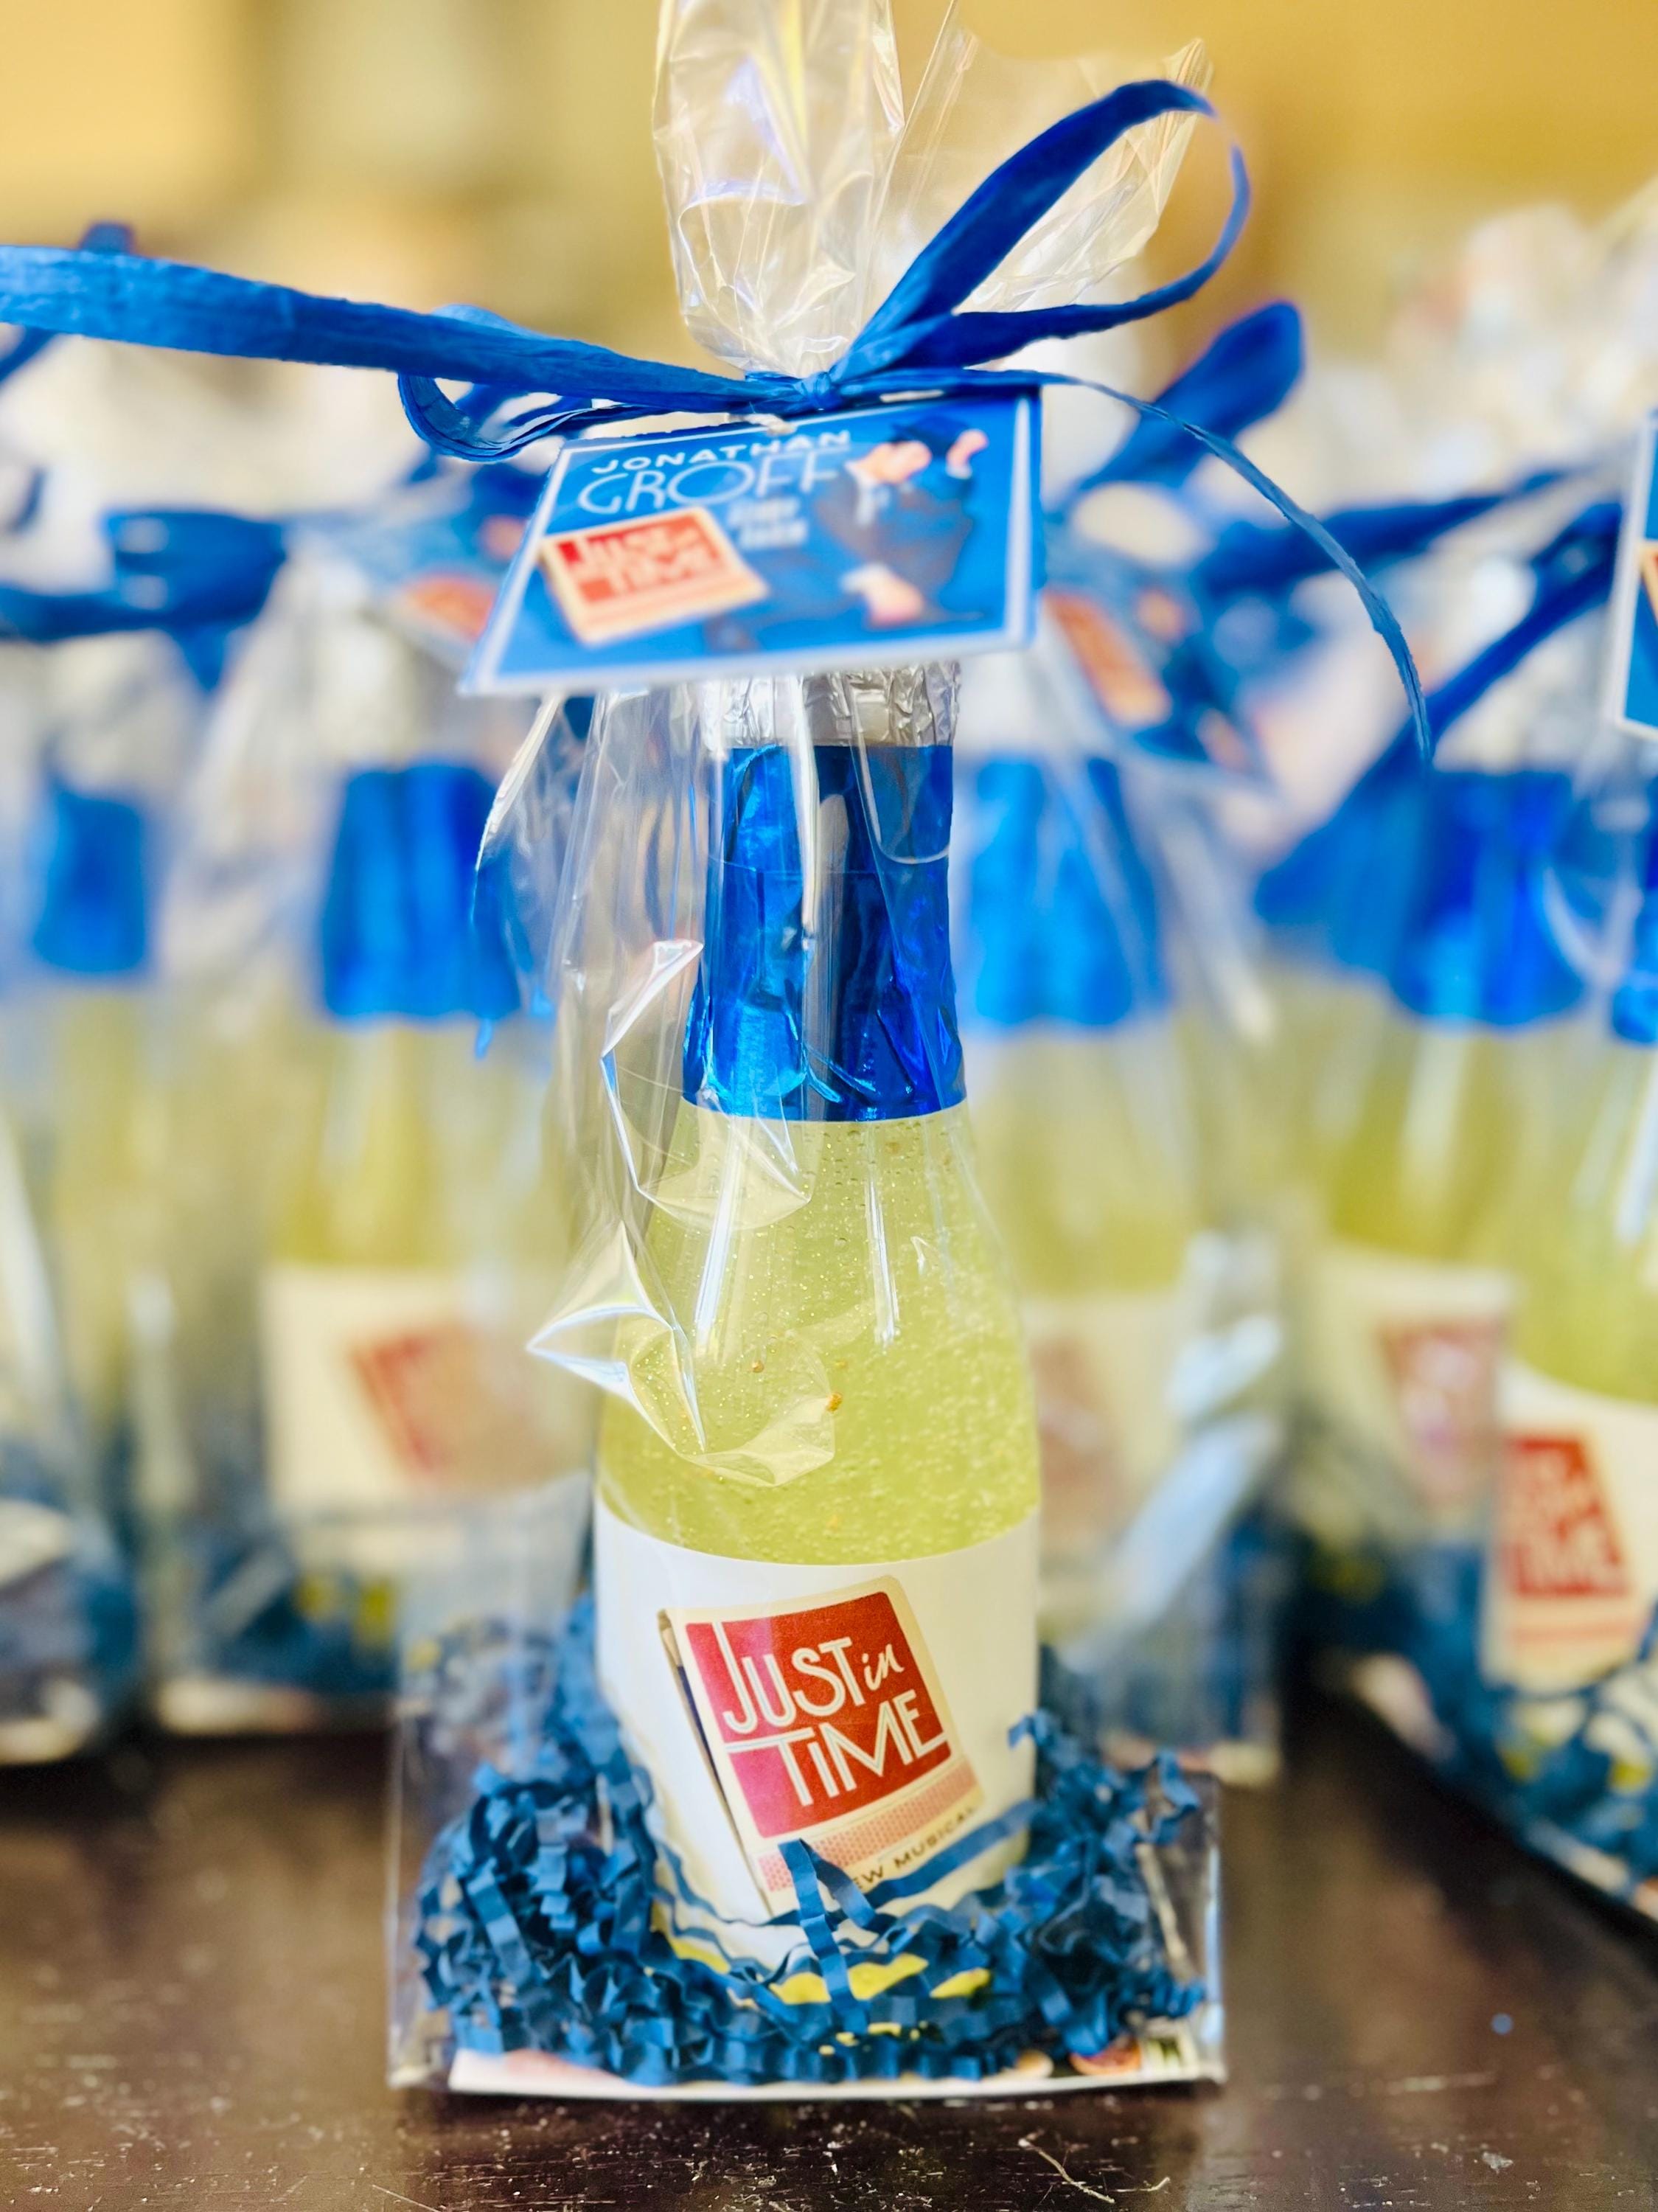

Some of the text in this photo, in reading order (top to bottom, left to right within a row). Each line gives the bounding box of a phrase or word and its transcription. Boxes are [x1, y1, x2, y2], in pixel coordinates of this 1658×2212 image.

[577, 446, 851, 515] GROFF
[591, 430, 851, 474] JONATHAN
[712, 1621, 905, 1734] JUST in
[724, 1688, 950, 1806] TIME
[851, 1865, 884, 1890] EW
